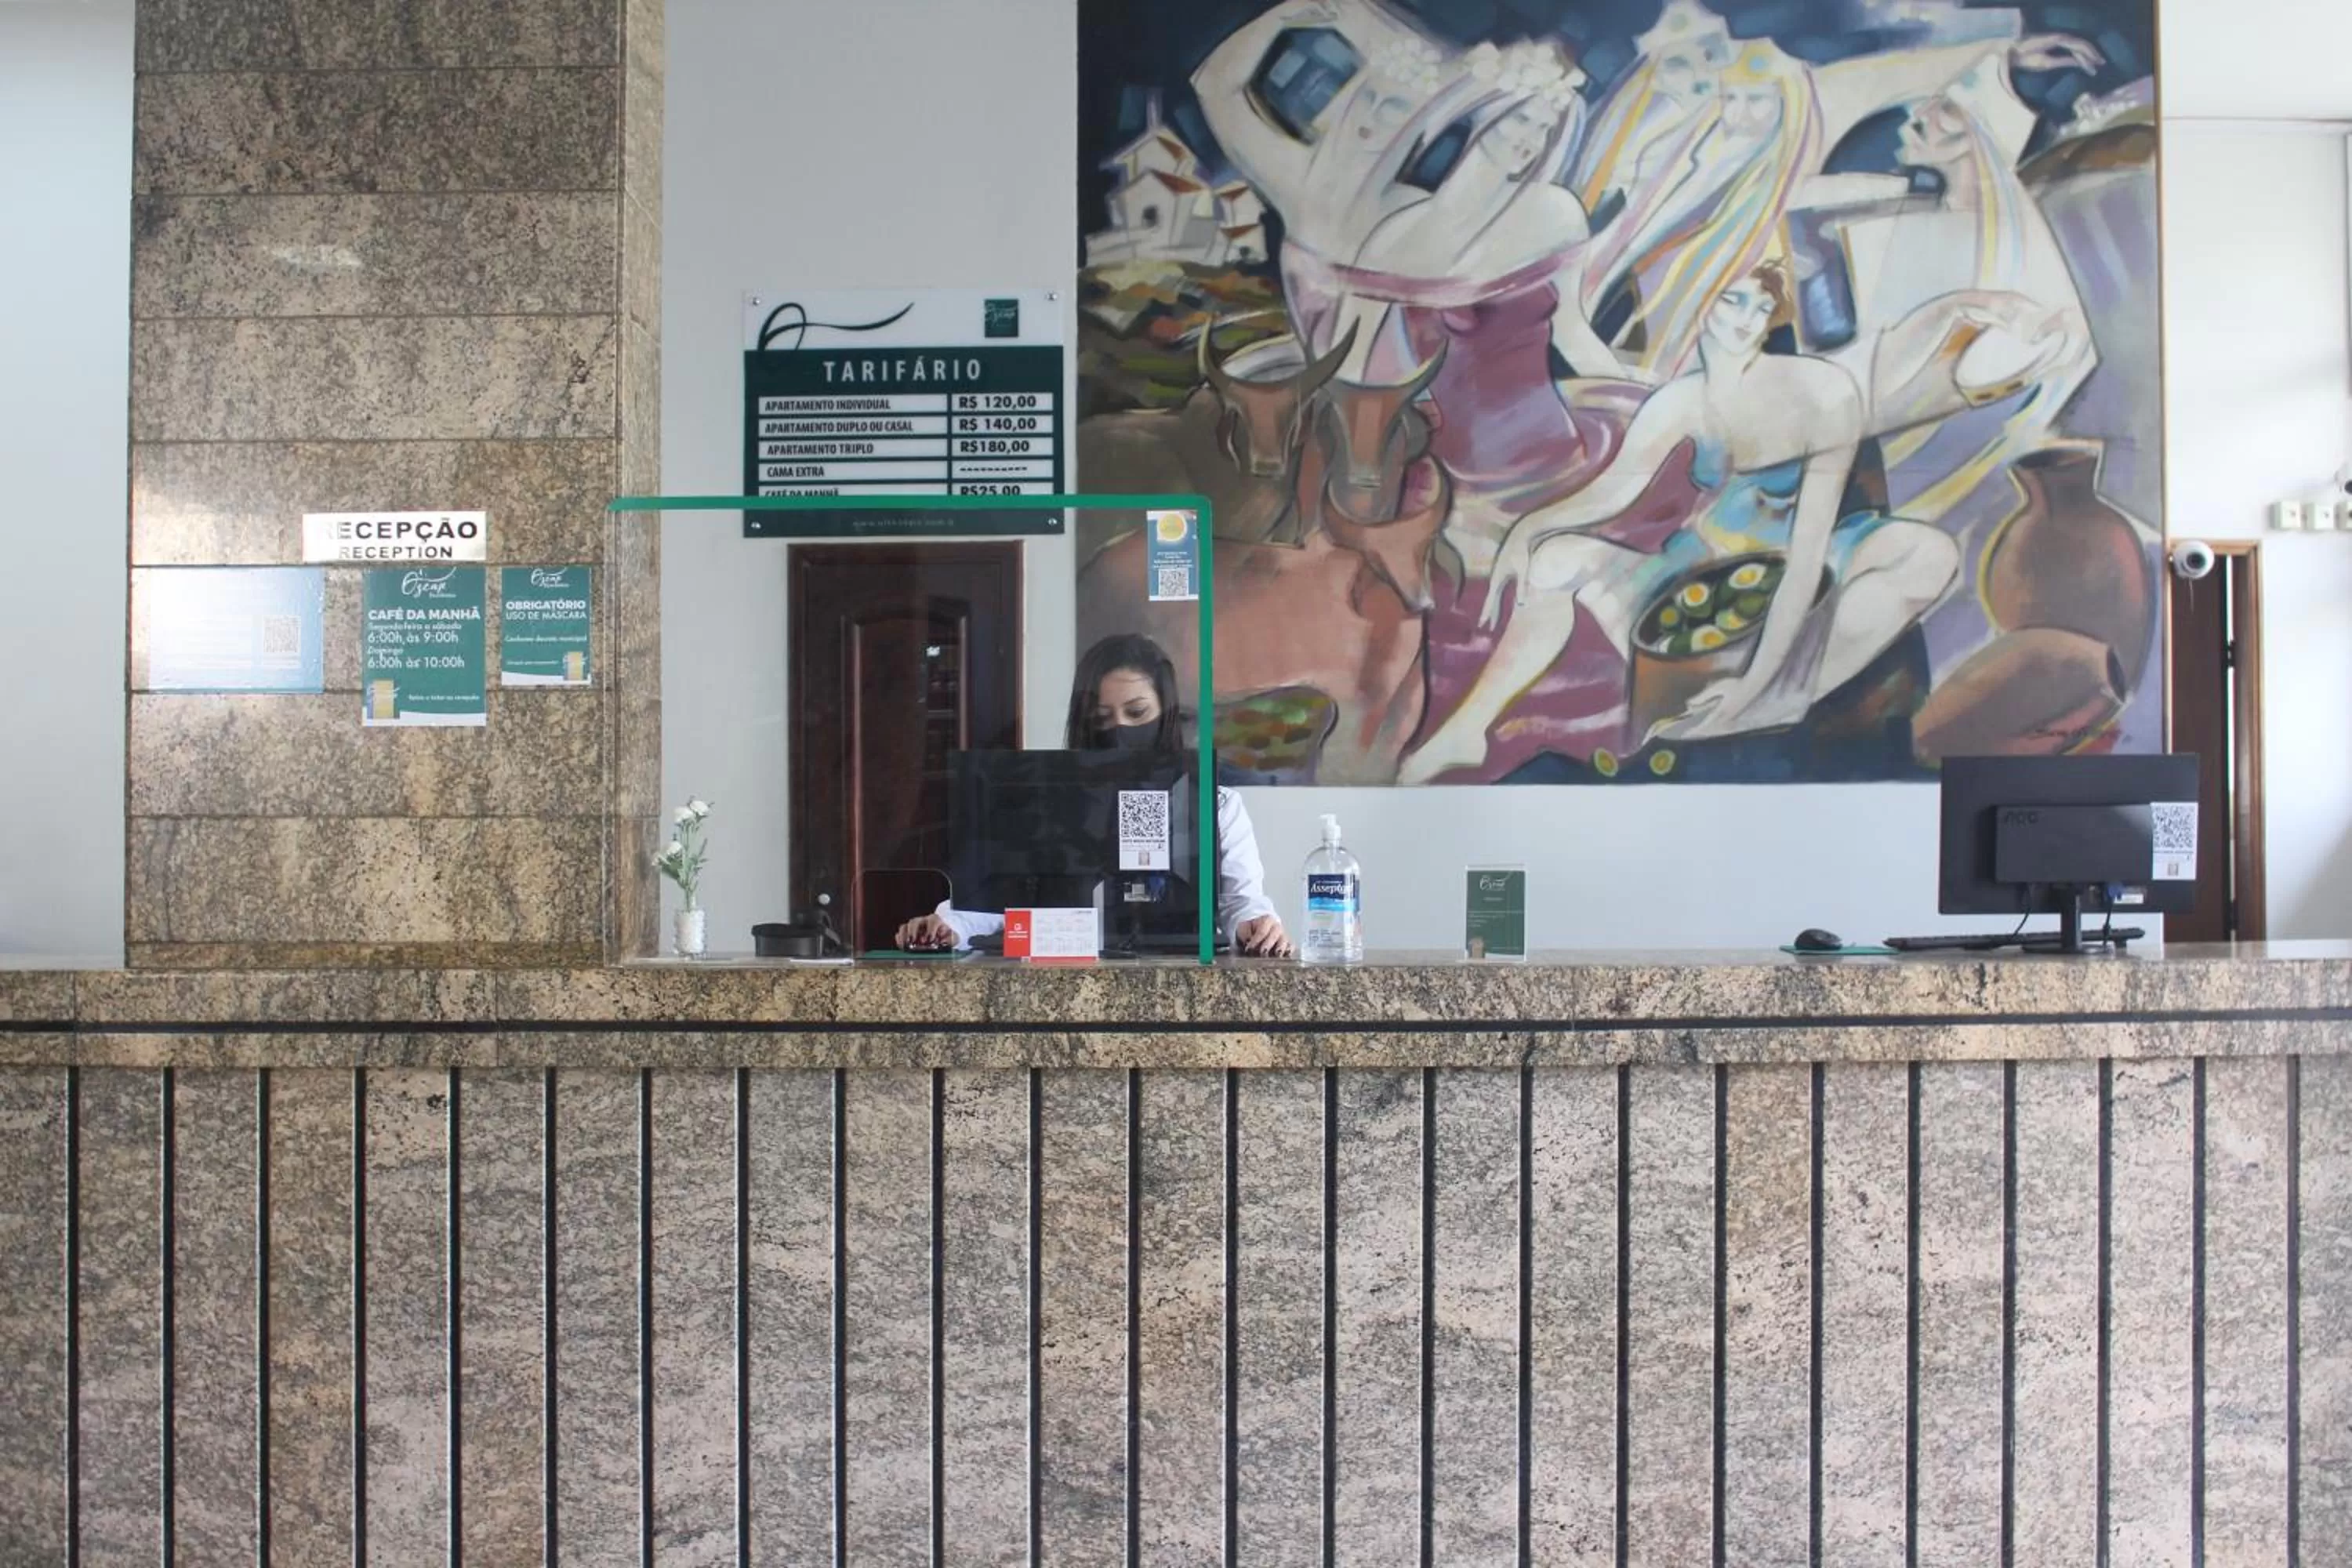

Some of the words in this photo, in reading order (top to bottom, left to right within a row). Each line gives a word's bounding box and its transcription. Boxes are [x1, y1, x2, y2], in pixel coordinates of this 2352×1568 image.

[822, 355, 981, 383] TARIFÁRIO
[764, 400, 834, 412] APARTAMENTO
[836, 398, 891, 410] INDIVIDUAL
[985, 395, 1036, 410] 120,00
[764, 421, 834, 434] APARTAMENTO
[836, 421, 867, 432] DUPLO
[869, 421, 884, 432] OU
[884, 420, 913, 431] CASAL
[985, 417, 1036, 432] 140,00
[768, 444, 837, 456] APARTAMENTO
[839, 443, 874, 454] TRIPLO
[767, 466, 793, 477] CAMA
[796, 466, 825, 477] EXTRA
[318, 517, 478, 543] ECEPÇÃO
[339, 546, 453, 559] RECEPTION
[505, 599, 586, 610] OBRIGATÓRIO
[368, 606, 404, 620] CAFÉ
[406, 609, 426, 620] DA
[429, 606, 481, 620] MANHÃ
[506, 612, 526, 620] USO
[528, 612, 539, 620] DE
